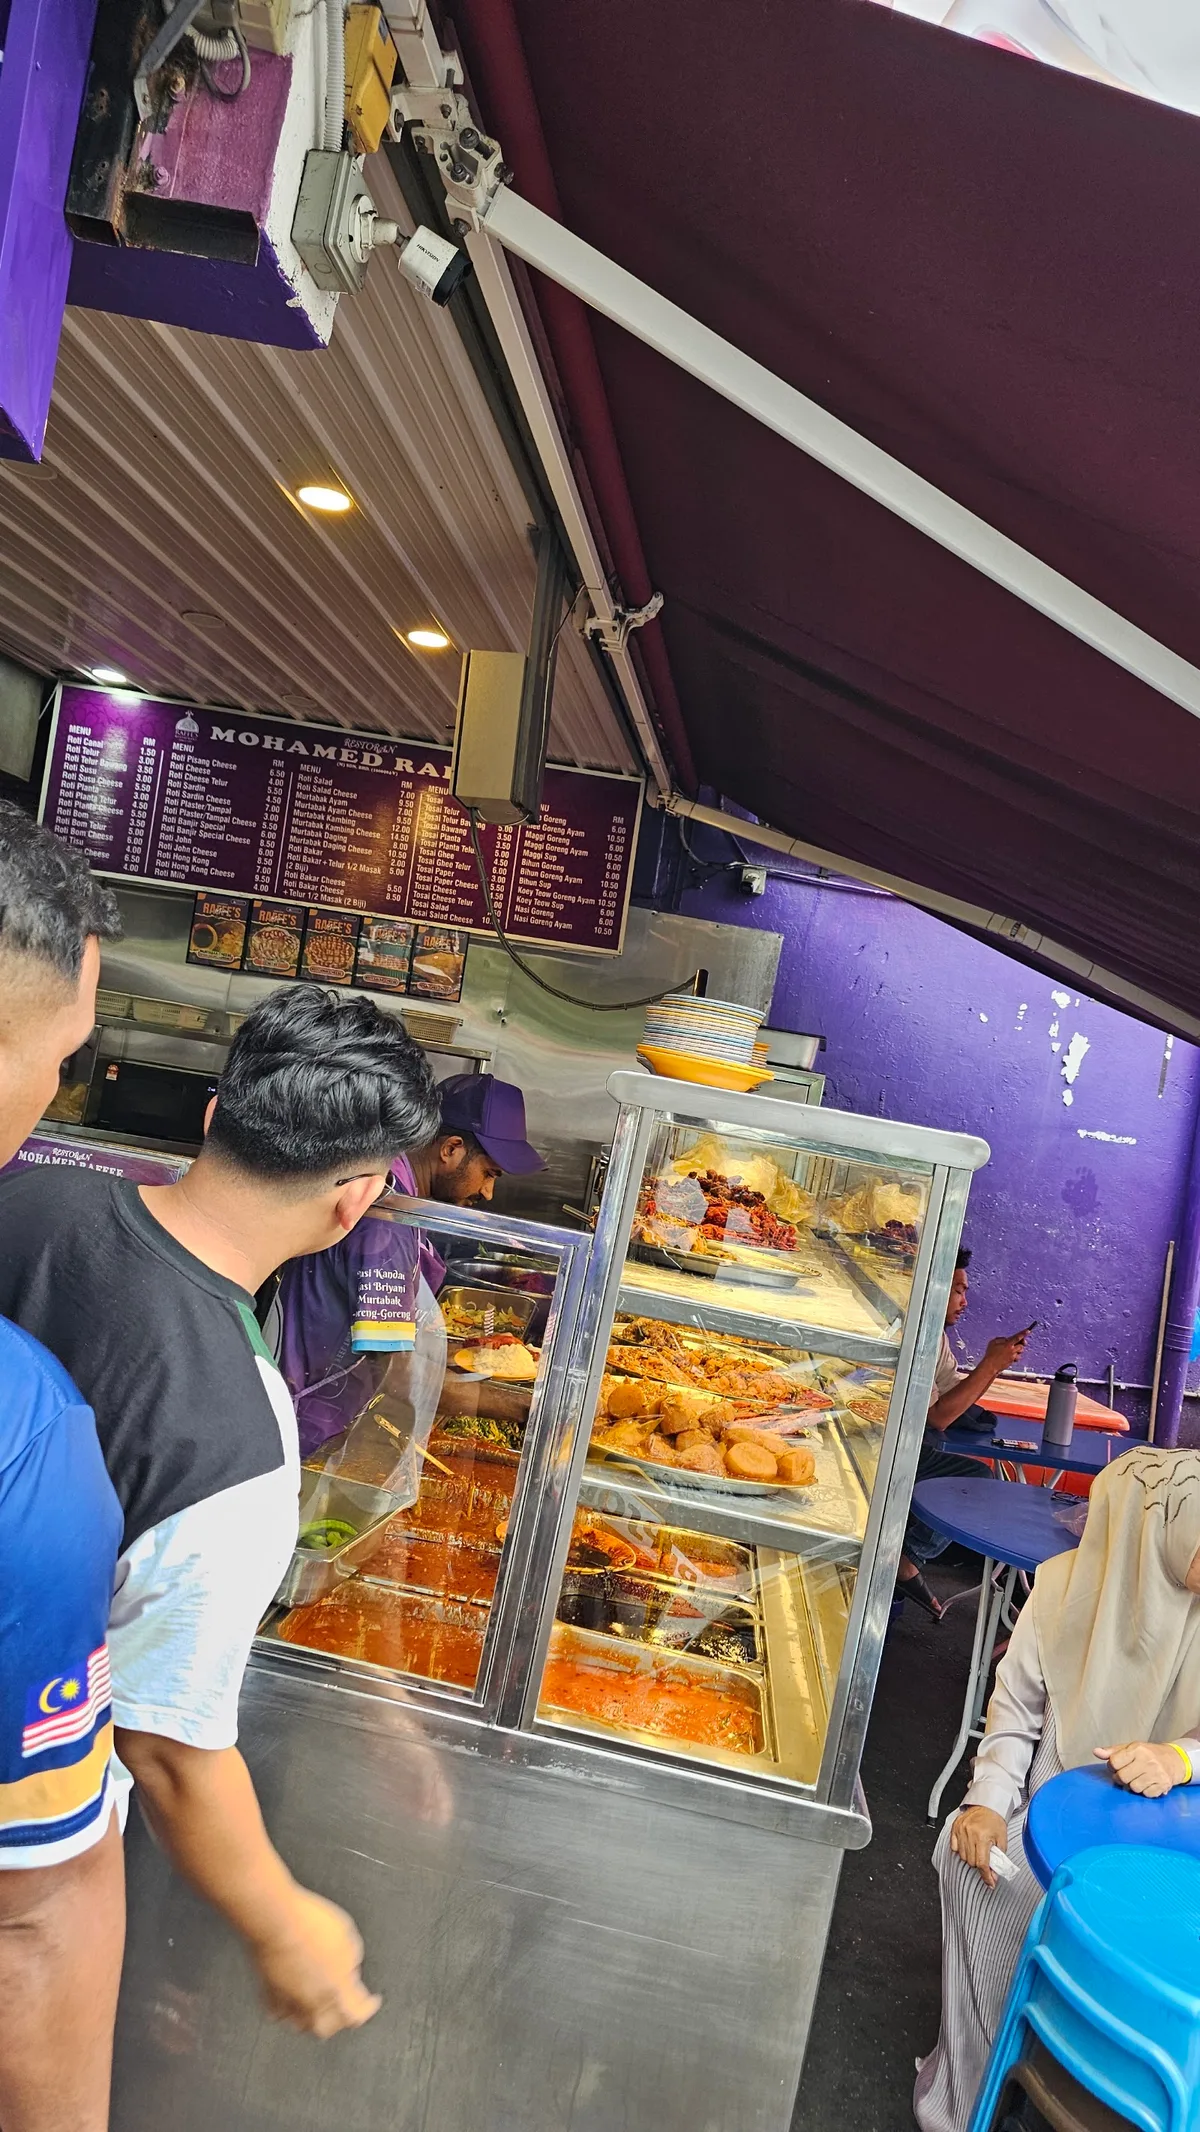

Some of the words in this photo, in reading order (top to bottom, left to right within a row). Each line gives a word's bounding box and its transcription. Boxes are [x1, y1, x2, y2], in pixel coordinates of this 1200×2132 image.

[67, 735, 82, 744] Roti
[83, 738, 103, 748] Canai
[69, 725, 91, 736] MENU
[143, 737, 156, 747] RM
[210, 726, 383, 767] MOHAMED
[344, 738, 398, 754] RESTORAN
[66, 744, 81, 753] Roti
[82, 747, 99, 756] Telur
[172, 742, 194, 753] MENU
[273, 759, 285, 768] RM
[169, 761, 184, 770] Roti
[185, 764, 210, 774] Cheese
[268, 778, 283, 787] 4.00
[171, 753, 185, 761] Roti
[186, 755, 210, 767] Pisang
[211, 760, 237, 770] Cheese
[269, 769, 285, 778] 6.50
[300, 763, 321, 774] MENU
[401, 781, 413, 790] RM
[167, 779, 181, 787] Roti
[183, 782, 205, 792] Sardin
[265, 795, 281, 804] 4.50
[168, 770, 183, 778] Roti
[184, 773, 209, 783] Cheese
[211, 778, 228, 786] Telur
[267, 786, 282, 795] 5.50
[298, 773, 312, 782] Roti
[313, 776, 332, 785] Salad
[400, 791, 415, 799] 7.00
[428, 785, 449, 796] MENU
[296, 791, 327, 802] Murtabak
[328, 797, 347, 806] Ayam
[397, 808, 412, 816] 7.00
[297, 782, 311, 790] Roti
[312, 785, 331, 794] Salad
[332, 788, 357, 798] Cheese
[398, 799, 414, 807] 9.50
[57, 807, 71, 815] Roti
[72, 809, 89, 818] Bom
[164, 797, 179, 805] Roti
[180, 799, 231, 814] Plaster/Tampal
[263, 813, 278, 822] 3.00
[293, 808, 325, 820] Murtabak
[326, 814, 355, 826] Kambing
[391, 824, 410, 833] 12.00
[294, 800, 326, 811] Murtabak
[327, 805, 346, 814] Ayam
[348, 809, 372, 819] Cheese
[396, 816, 411, 824] 9.50
[612, 815, 624, 824] RM
[54, 825, 68, 833] Roti
[69, 827, 86, 836] Bom
[87, 830, 113, 841] Cheese
[162, 814, 176, 823] Roti
[177, 817, 198, 827] Banjir
[199, 821, 225, 831] Special
[260, 830, 276, 839] 6.00
[542, 824, 565, 835] Goreng
[566, 828, 584, 837] Ayam
[606, 834, 625, 843] 10.50
[543, 815, 566, 826] Goreng
[611, 826, 626, 834] 6.00
[159, 832, 174, 840] Roti
[175, 835, 192, 844] John
[258, 848, 273, 857] 6.00
[289, 835, 321, 846] Murtabak
[322, 840, 346, 852] Daging
[347, 845, 372, 855] Cheese
[388, 850, 406, 859] 10.50
[291, 826, 322, 837] Murtabak
[323, 832, 347, 843] Daging
[393, 842, 408, 850] 8.00
[525, 830, 545, 841] Maggi
[546, 834, 569, 845] Goreng
[609, 844, 623, 853] 6.00
[156, 850, 171, 858] Roti
[172, 853, 190, 863] Hong
[191, 856, 209, 866] Kong
[255, 866, 271, 874] 7.00
[288, 843, 302, 852] Roti
[303, 846, 322, 855] Bakar
[390, 859, 405, 867] 2.00
[419, 847, 436, 856] Tosai
[437, 850, 454, 859] Ghee
[493, 858, 508, 867] 4.50
[523, 849, 543, 859] Maggi
[544, 852, 557, 862] Sup
[606, 862, 621, 871] 6.00
[524, 840, 544, 850] Maggi
[545, 843, 568, 855] Goreng
[570, 847, 588, 856] Ayam
[604, 853, 622, 862] 10.50
[154, 868, 168, 876] Roti
[170, 870, 185, 879] Milo
[253, 883, 268, 892] 4.00
[416, 864, 433, 873] Tosai
[435, 867, 454, 877] Paper
[490, 875, 506, 884] 3.00
[520, 867, 538, 876] Bihun
[540, 870, 562, 882] Goreng
[564, 874, 582, 884] Ayam
[600, 880, 618, 889] 10.50
[521, 858, 539, 867] Bihun
[541, 861, 564, 873] Goreng
[605, 872, 620, 880] 6.00
[415, 872, 432, 881] Tosai
[433, 876, 453, 885] Paper
[454, 879, 478, 889] Cheese
[489, 883, 505, 892] 5.50
[519, 876, 537, 886] Bihun
[538, 880, 551, 889] Sup
[602, 890, 617, 899] 6.00
[516, 895, 532, 905] Koey
[533, 898, 549, 906] Teow
[551, 901, 564, 910] Sup
[600, 908, 614, 917] 6.00
[517, 886, 533, 896] Koey
[535, 888, 551, 897] Teow
[552, 891, 575, 903] Goreng
[577, 895, 595, 905] Ayam
[597, 899, 616, 908] 10.50
[513, 913, 528, 922] Nasi
[529, 916, 552, 927] Goreng
[554, 920, 572, 929] Ayam
[594, 926, 612, 935] 10.50
[515, 904, 529, 913] Nasi
[531, 907, 554, 918] Goreng
[598, 918, 613, 926] 6.00
[18, 1150, 76, 1167] MOHAMED
[53, 1147, 93, 1161] RESTORAN
[357, 1269, 371, 1279] asi
[358, 1282, 371, 1291] asi
[373, 1282, 406, 1294] Briyani
[358, 1293, 402, 1307] Murtabak
[353, 1309, 411, 1321] reng-Goreng
